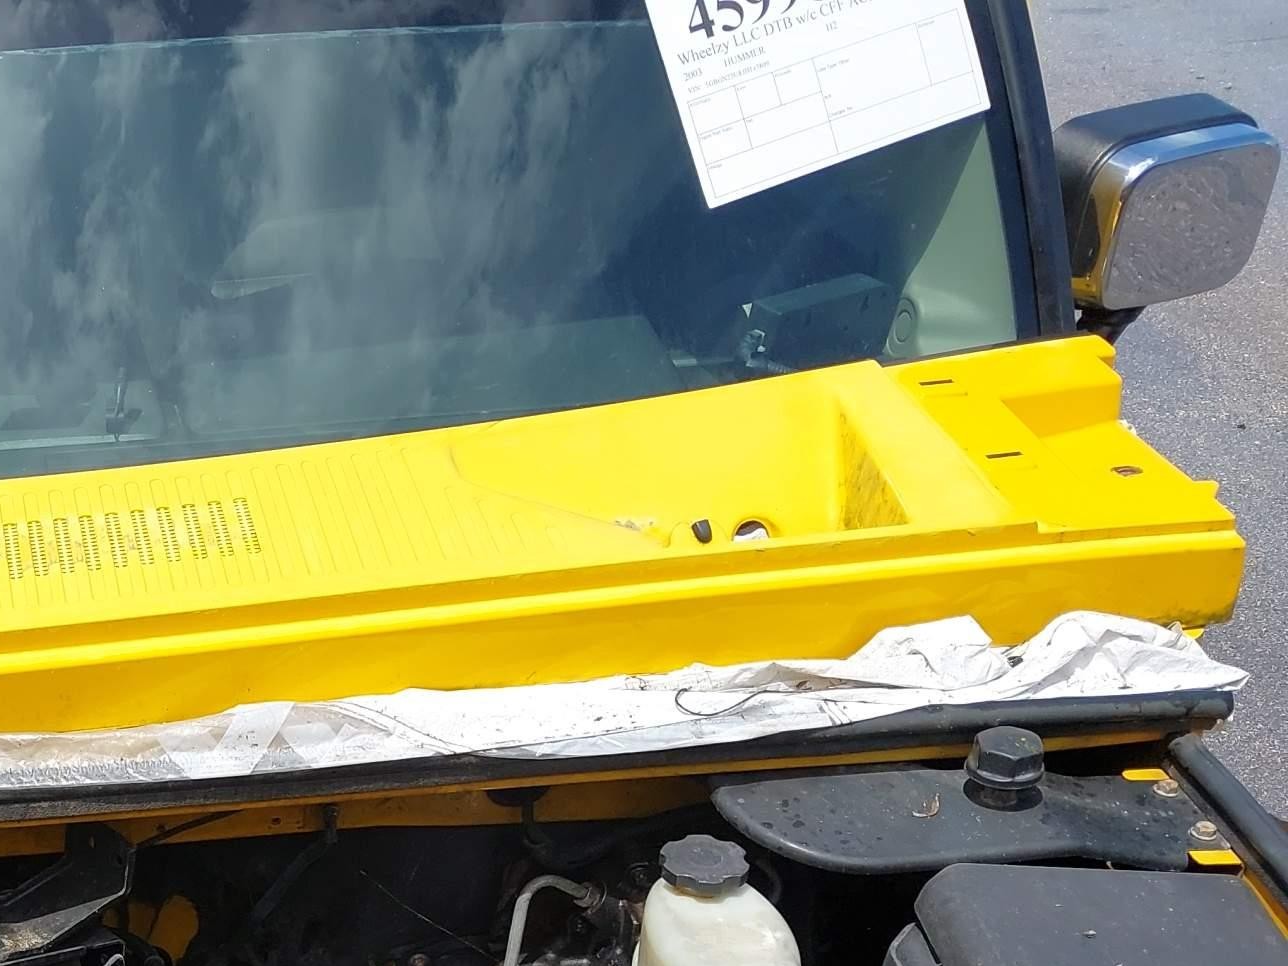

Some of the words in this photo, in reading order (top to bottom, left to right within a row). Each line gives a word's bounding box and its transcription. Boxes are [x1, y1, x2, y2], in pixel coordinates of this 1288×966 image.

[677, 40, 729, 66] Wheelzy
[732, 27, 762, 48] LLC
[763, 15, 793, 36] DTB
[796, 9, 817, 26] w/c
[723, 45, 766, 68] HUMMER
